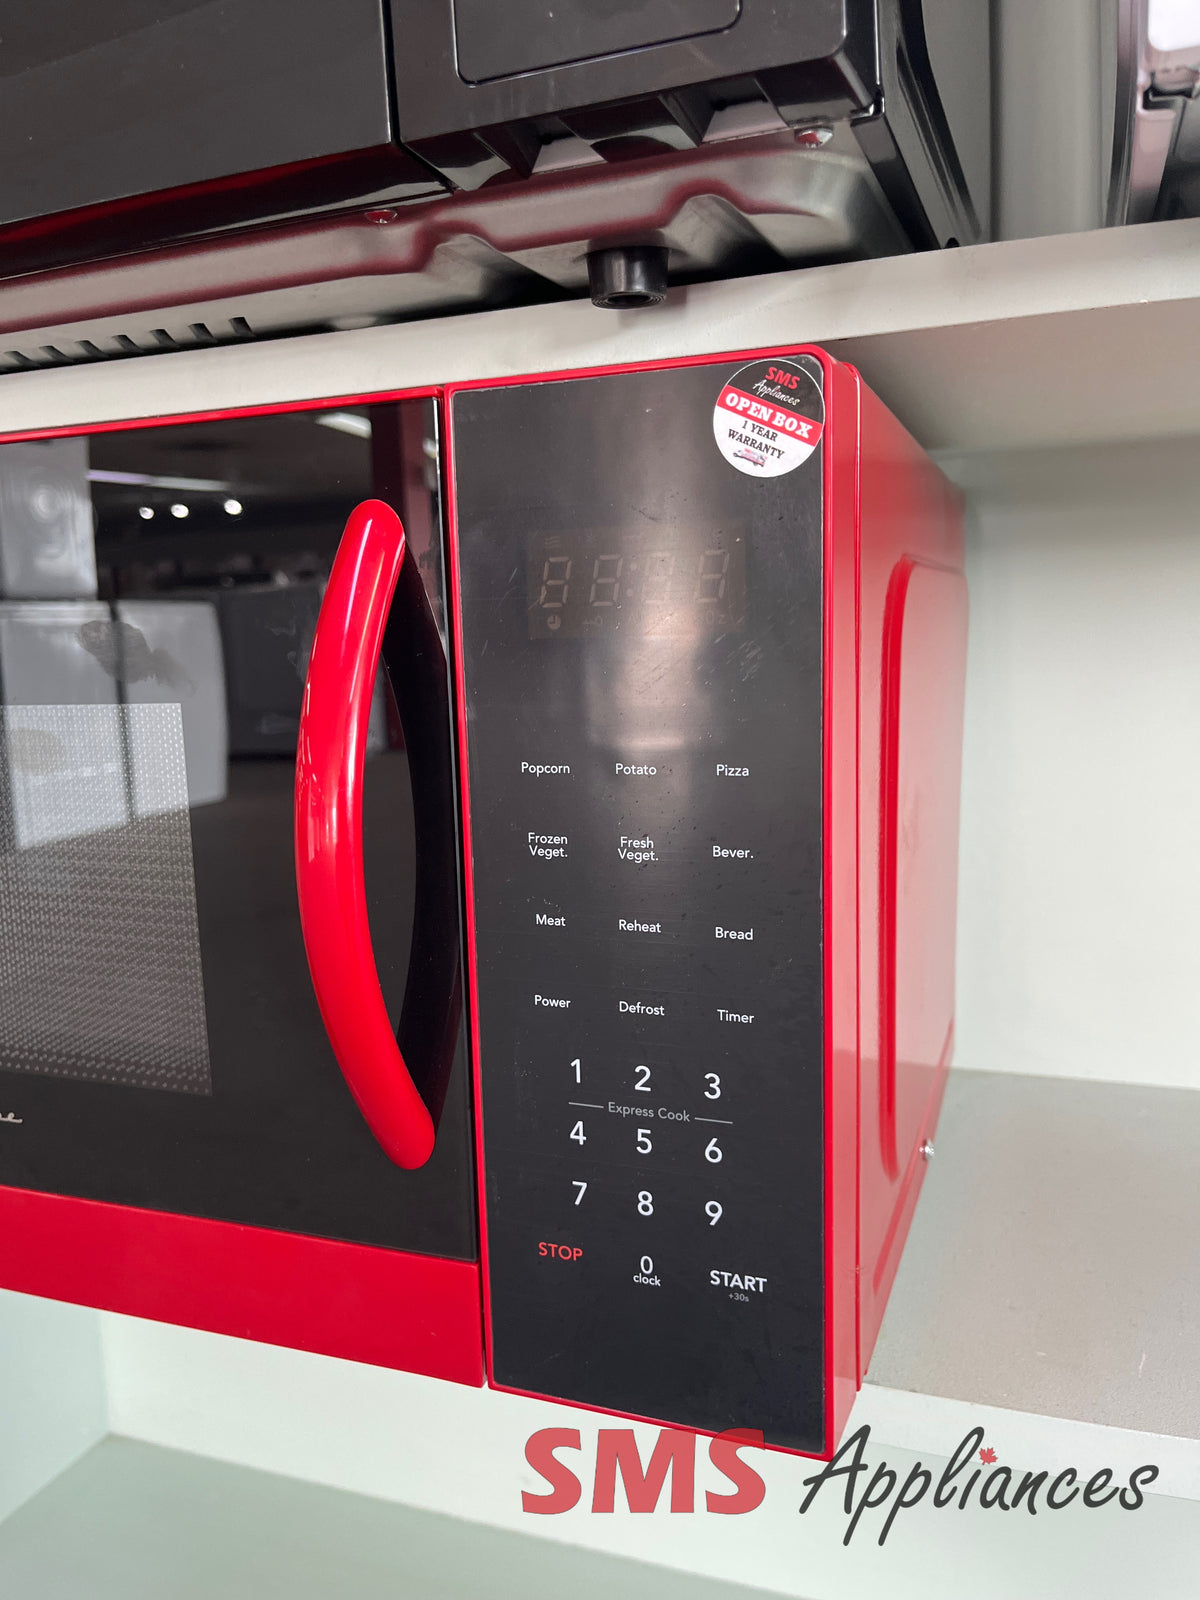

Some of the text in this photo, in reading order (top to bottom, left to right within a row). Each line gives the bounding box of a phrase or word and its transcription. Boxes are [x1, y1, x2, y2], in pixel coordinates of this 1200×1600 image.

[765, 366, 800, 390] SMS
[752, 379, 801, 406] Appliances
[725, 393, 813, 439] OPEN BOX
[742, 420, 778, 442] 1 YEAR
[728, 428, 785, 459] WARRANTY
[521, 762, 570, 777] Popcorn
[615, 763, 657, 776] Potato
[716, 764, 750, 777] Pizza
[528, 832, 568, 845] Frozen
[620, 836, 654, 849] Fresh
[529, 845, 568, 860] Veget.
[617, 848, 659, 863] Veget.
[712, 846, 754, 859] Bever.
[535, 914, 566, 927] Meat
[618, 919, 662, 933] Reheat
[715, 927, 754, 941] Bread
[534, 995, 571, 1009] Power
[619, 1001, 665, 1016] Defrost
[717, 1009, 755, 1024] Timer
[570, 1058, 722, 1100] 1 2 3
[608, 1101, 690, 1122] Express Cook
[569, 1120, 723, 1164] 4 5 6
[572, 1180, 723, 1227] 7 8 9
[538, 1241, 583, 1261] STOP
[640, 1255, 654, 1275] 0
[633, 1273, 661, 1287] clock
[709, 1269, 767, 1293] START
